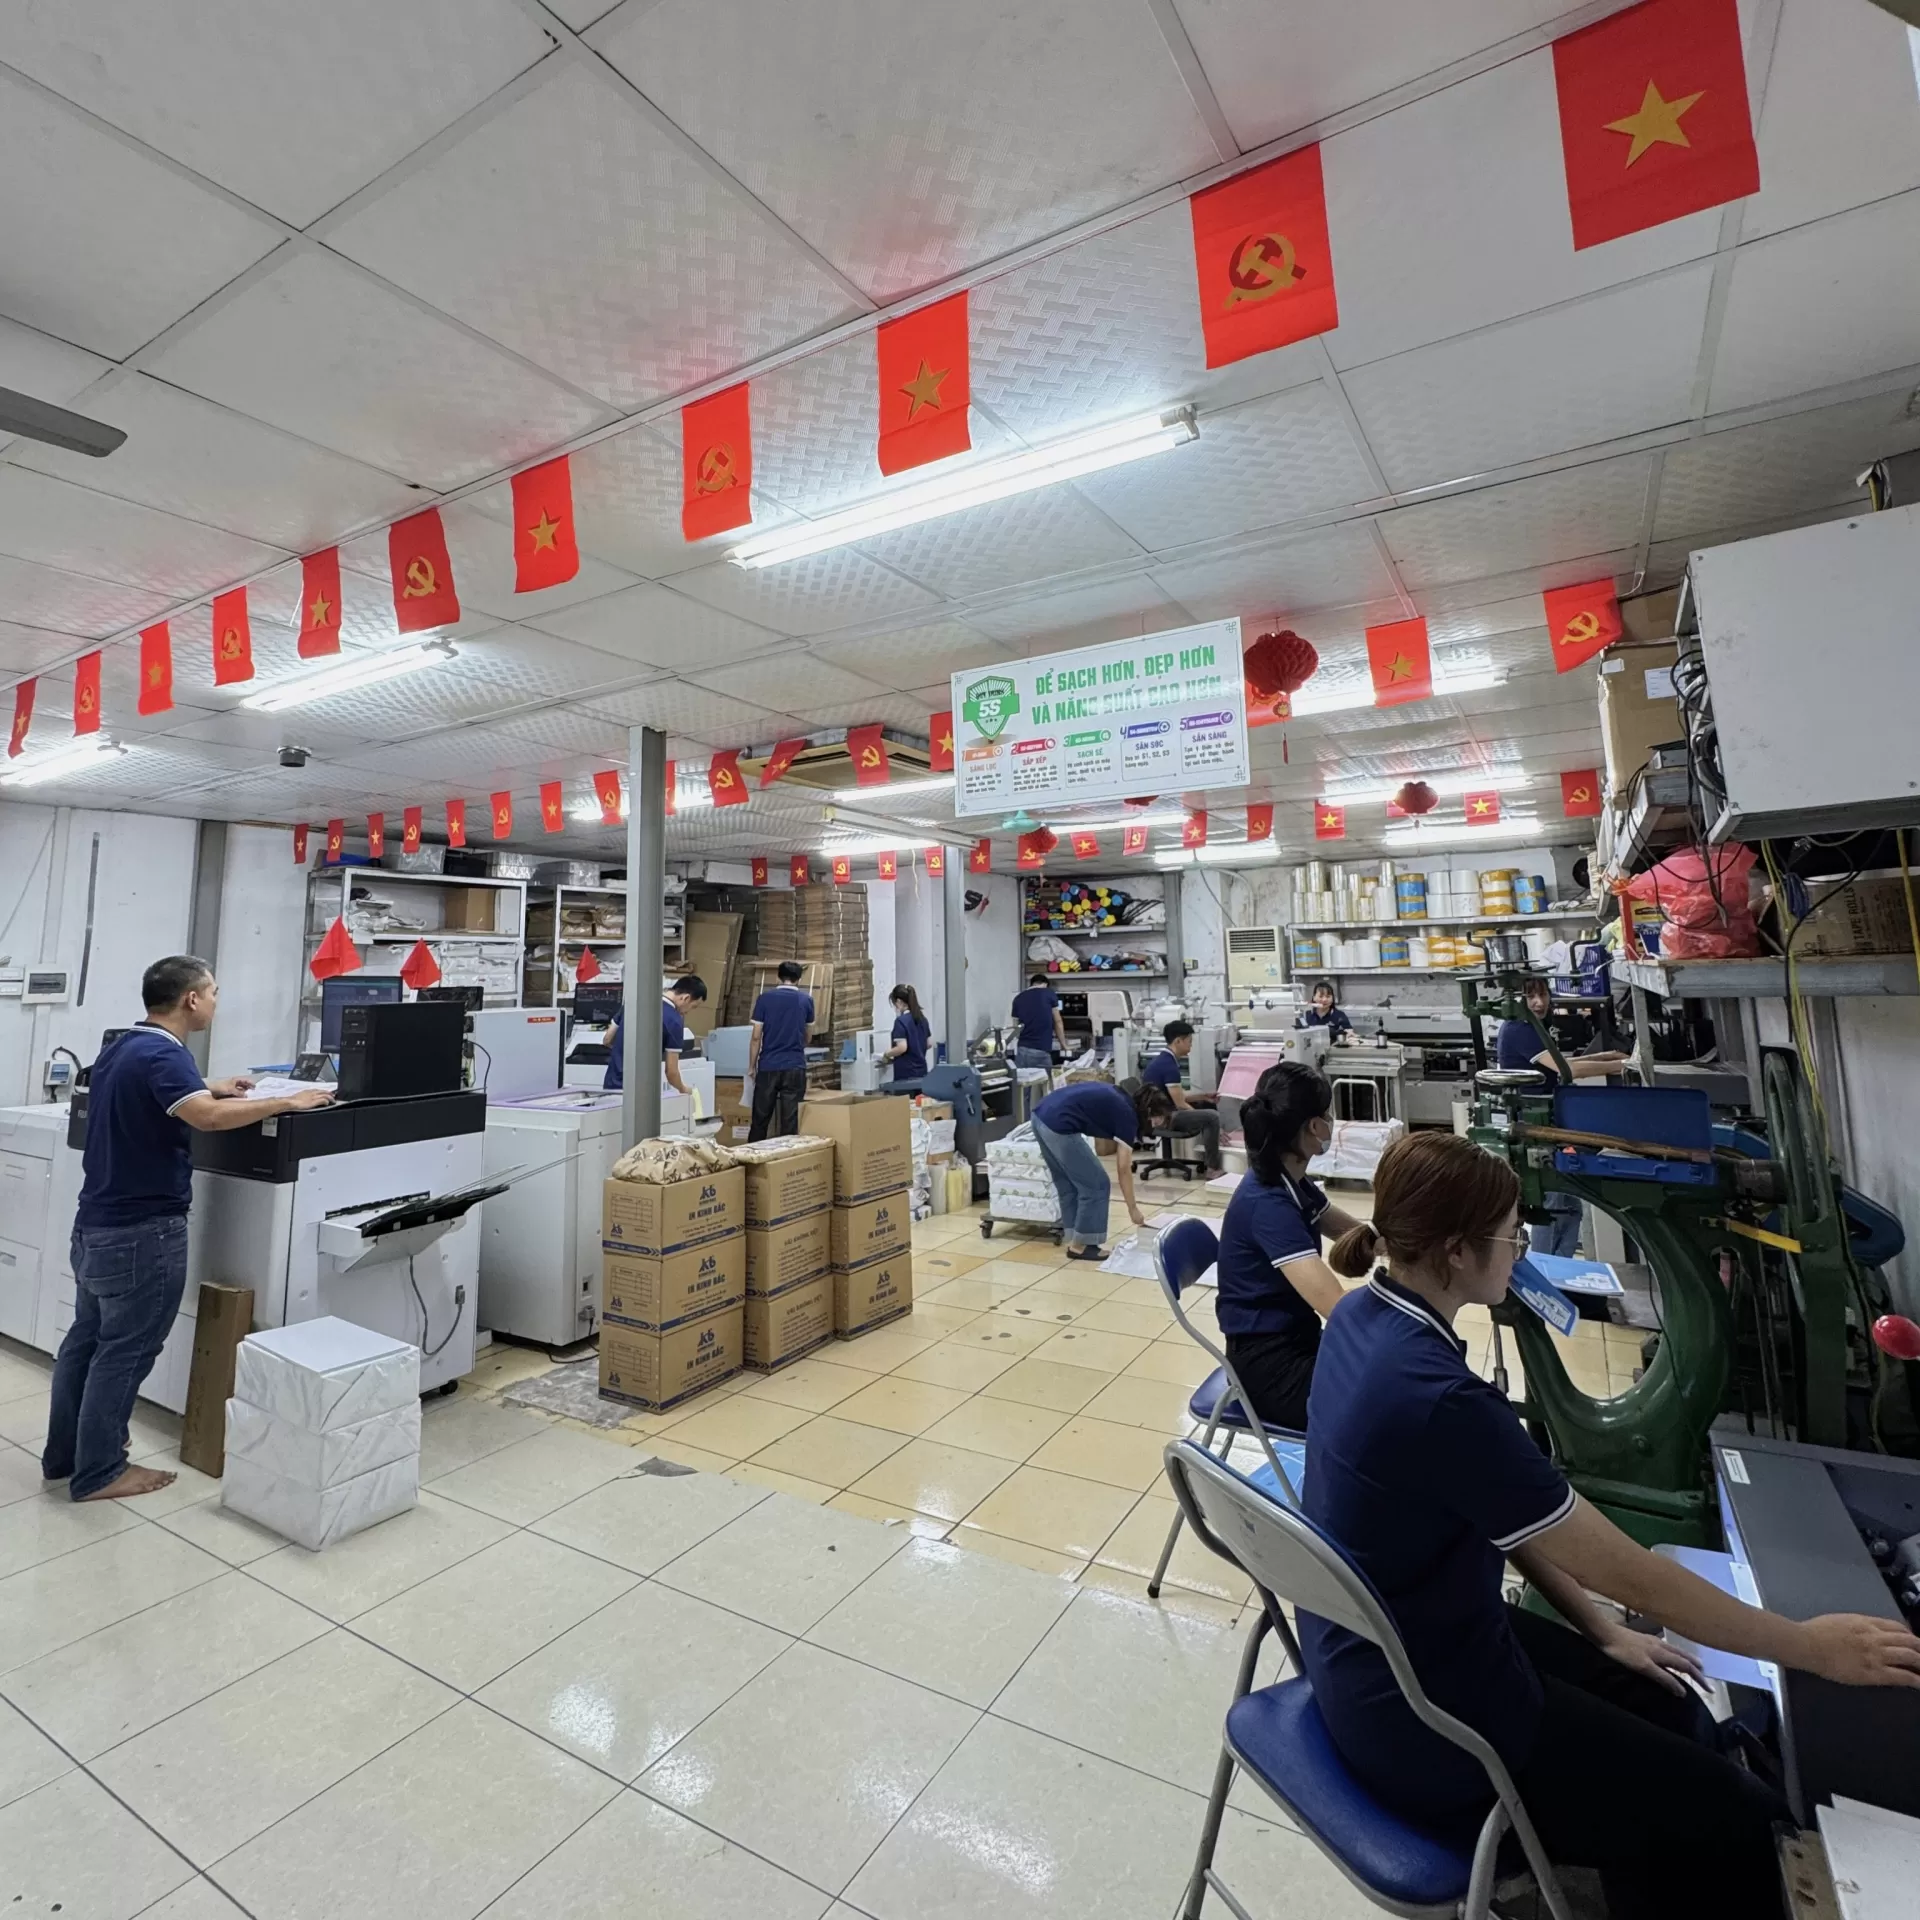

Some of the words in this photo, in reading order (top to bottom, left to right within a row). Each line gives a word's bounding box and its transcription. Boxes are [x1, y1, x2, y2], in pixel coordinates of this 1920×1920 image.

[1035, 668, 1054, 695] ĐỂ
[1057, 667, 1097, 694] SẠCH
[1144, 653, 1174, 680] ĐẸP
[1179, 645, 1215, 670] HƠN
[979, 699, 1001, 717] 5S
[1032, 701, 1051, 725] VÀ
[1055, 696, 1098, 722] NĂNG
[1103, 684, 1143, 714] SUẤT
[1148, 682, 1180, 707] CAO
[1120, 726, 1127, 739] 4
[1180, 718, 1187, 731] 5
[1063, 735, 1070, 747] 3
[1844, 886, 1859, 915] ROLLS
[1851, 917, 1865, 940] TAPE
